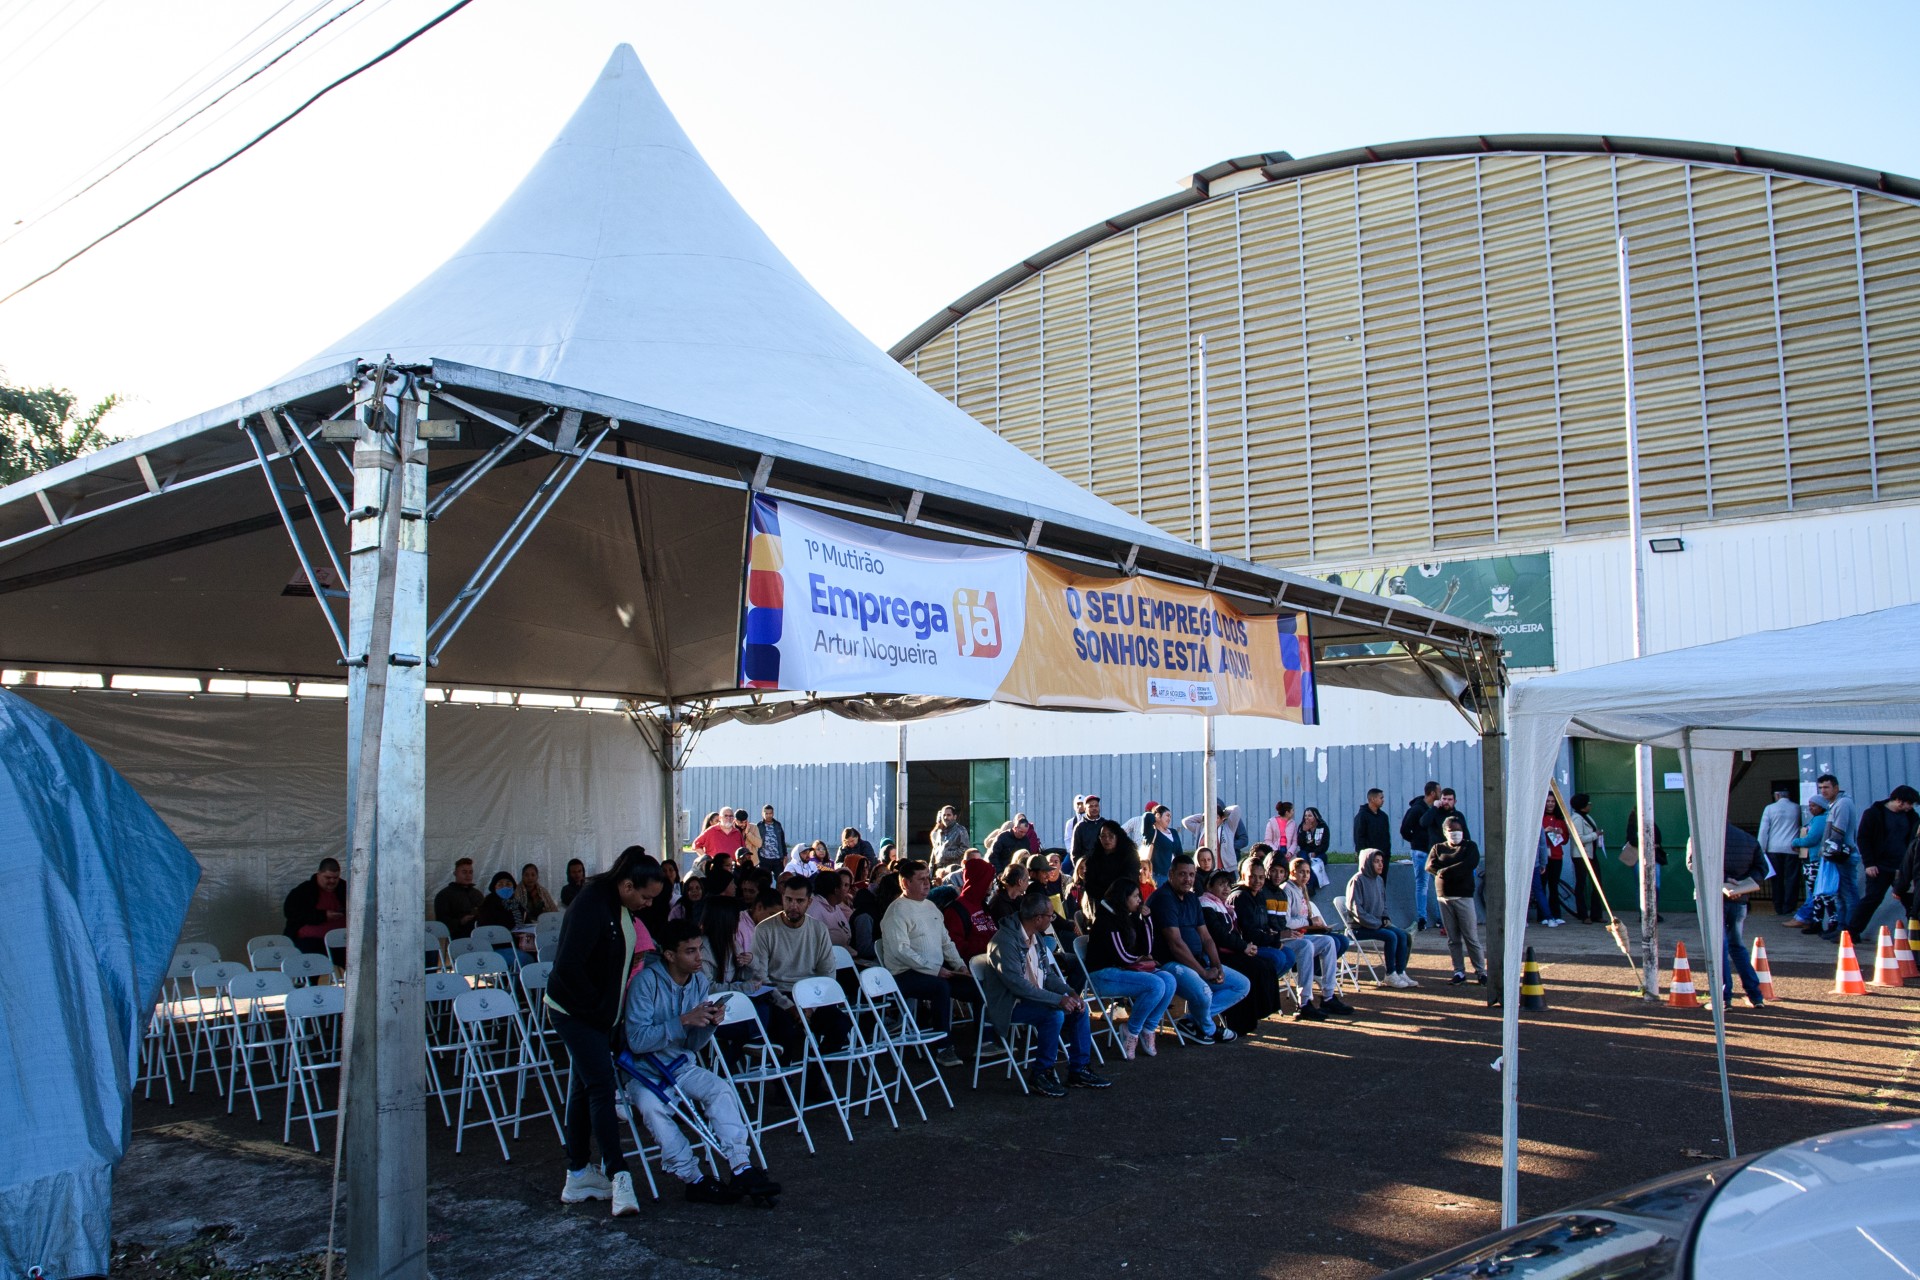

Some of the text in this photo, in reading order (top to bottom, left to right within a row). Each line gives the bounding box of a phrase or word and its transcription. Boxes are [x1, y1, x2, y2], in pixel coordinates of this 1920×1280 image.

[805, 539, 884, 575] 1º Mutirão
[808, 572, 998, 657] Emprega já
[1066, 587, 1248, 647] O SEU EMPREGO DOS
[1493, 623, 1544, 634] NOGUEIRA
[814, 630, 938, 666] Artur Nogueira
[1073, 627, 1252, 680] SONHOS ESTÁ AQUI!
